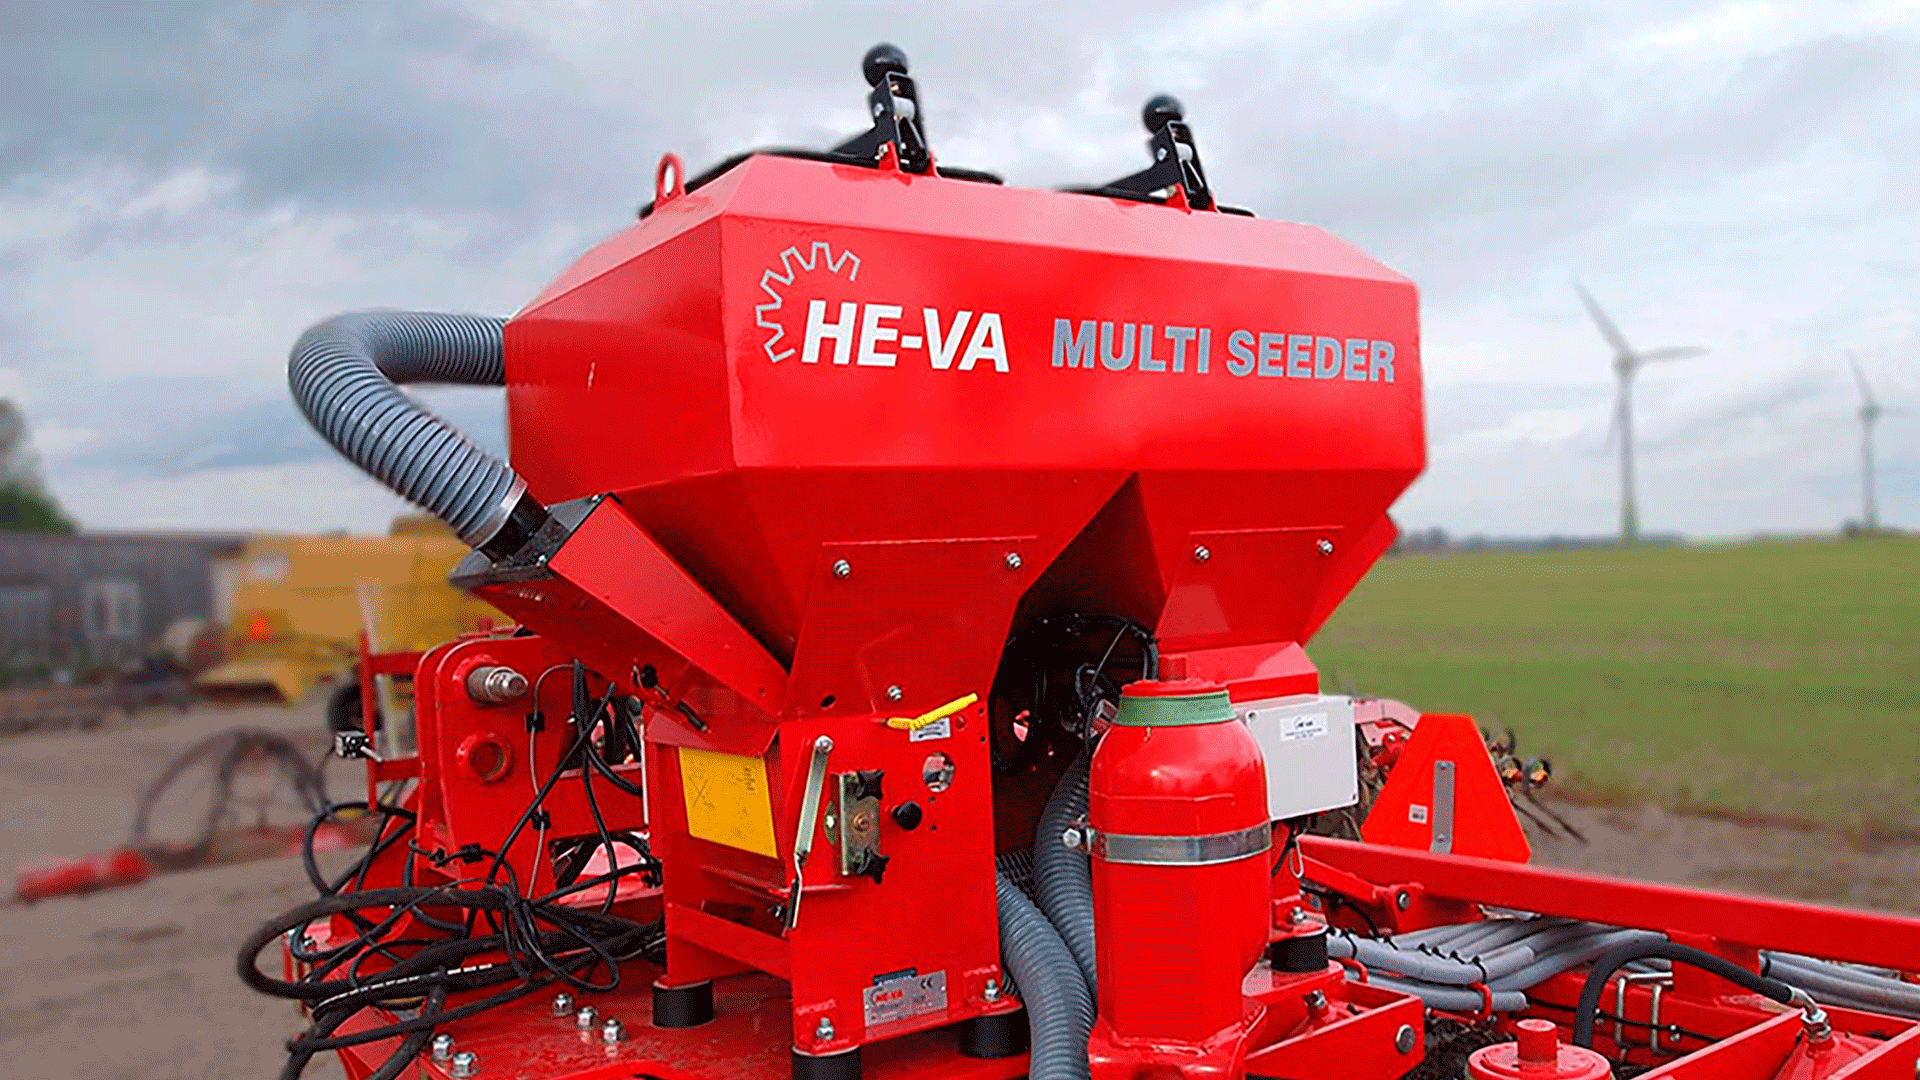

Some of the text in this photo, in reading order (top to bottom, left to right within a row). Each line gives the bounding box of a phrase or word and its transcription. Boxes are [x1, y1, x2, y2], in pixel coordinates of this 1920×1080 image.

[801, 299, 1397, 383] HE-VA MULTI SEEDER
